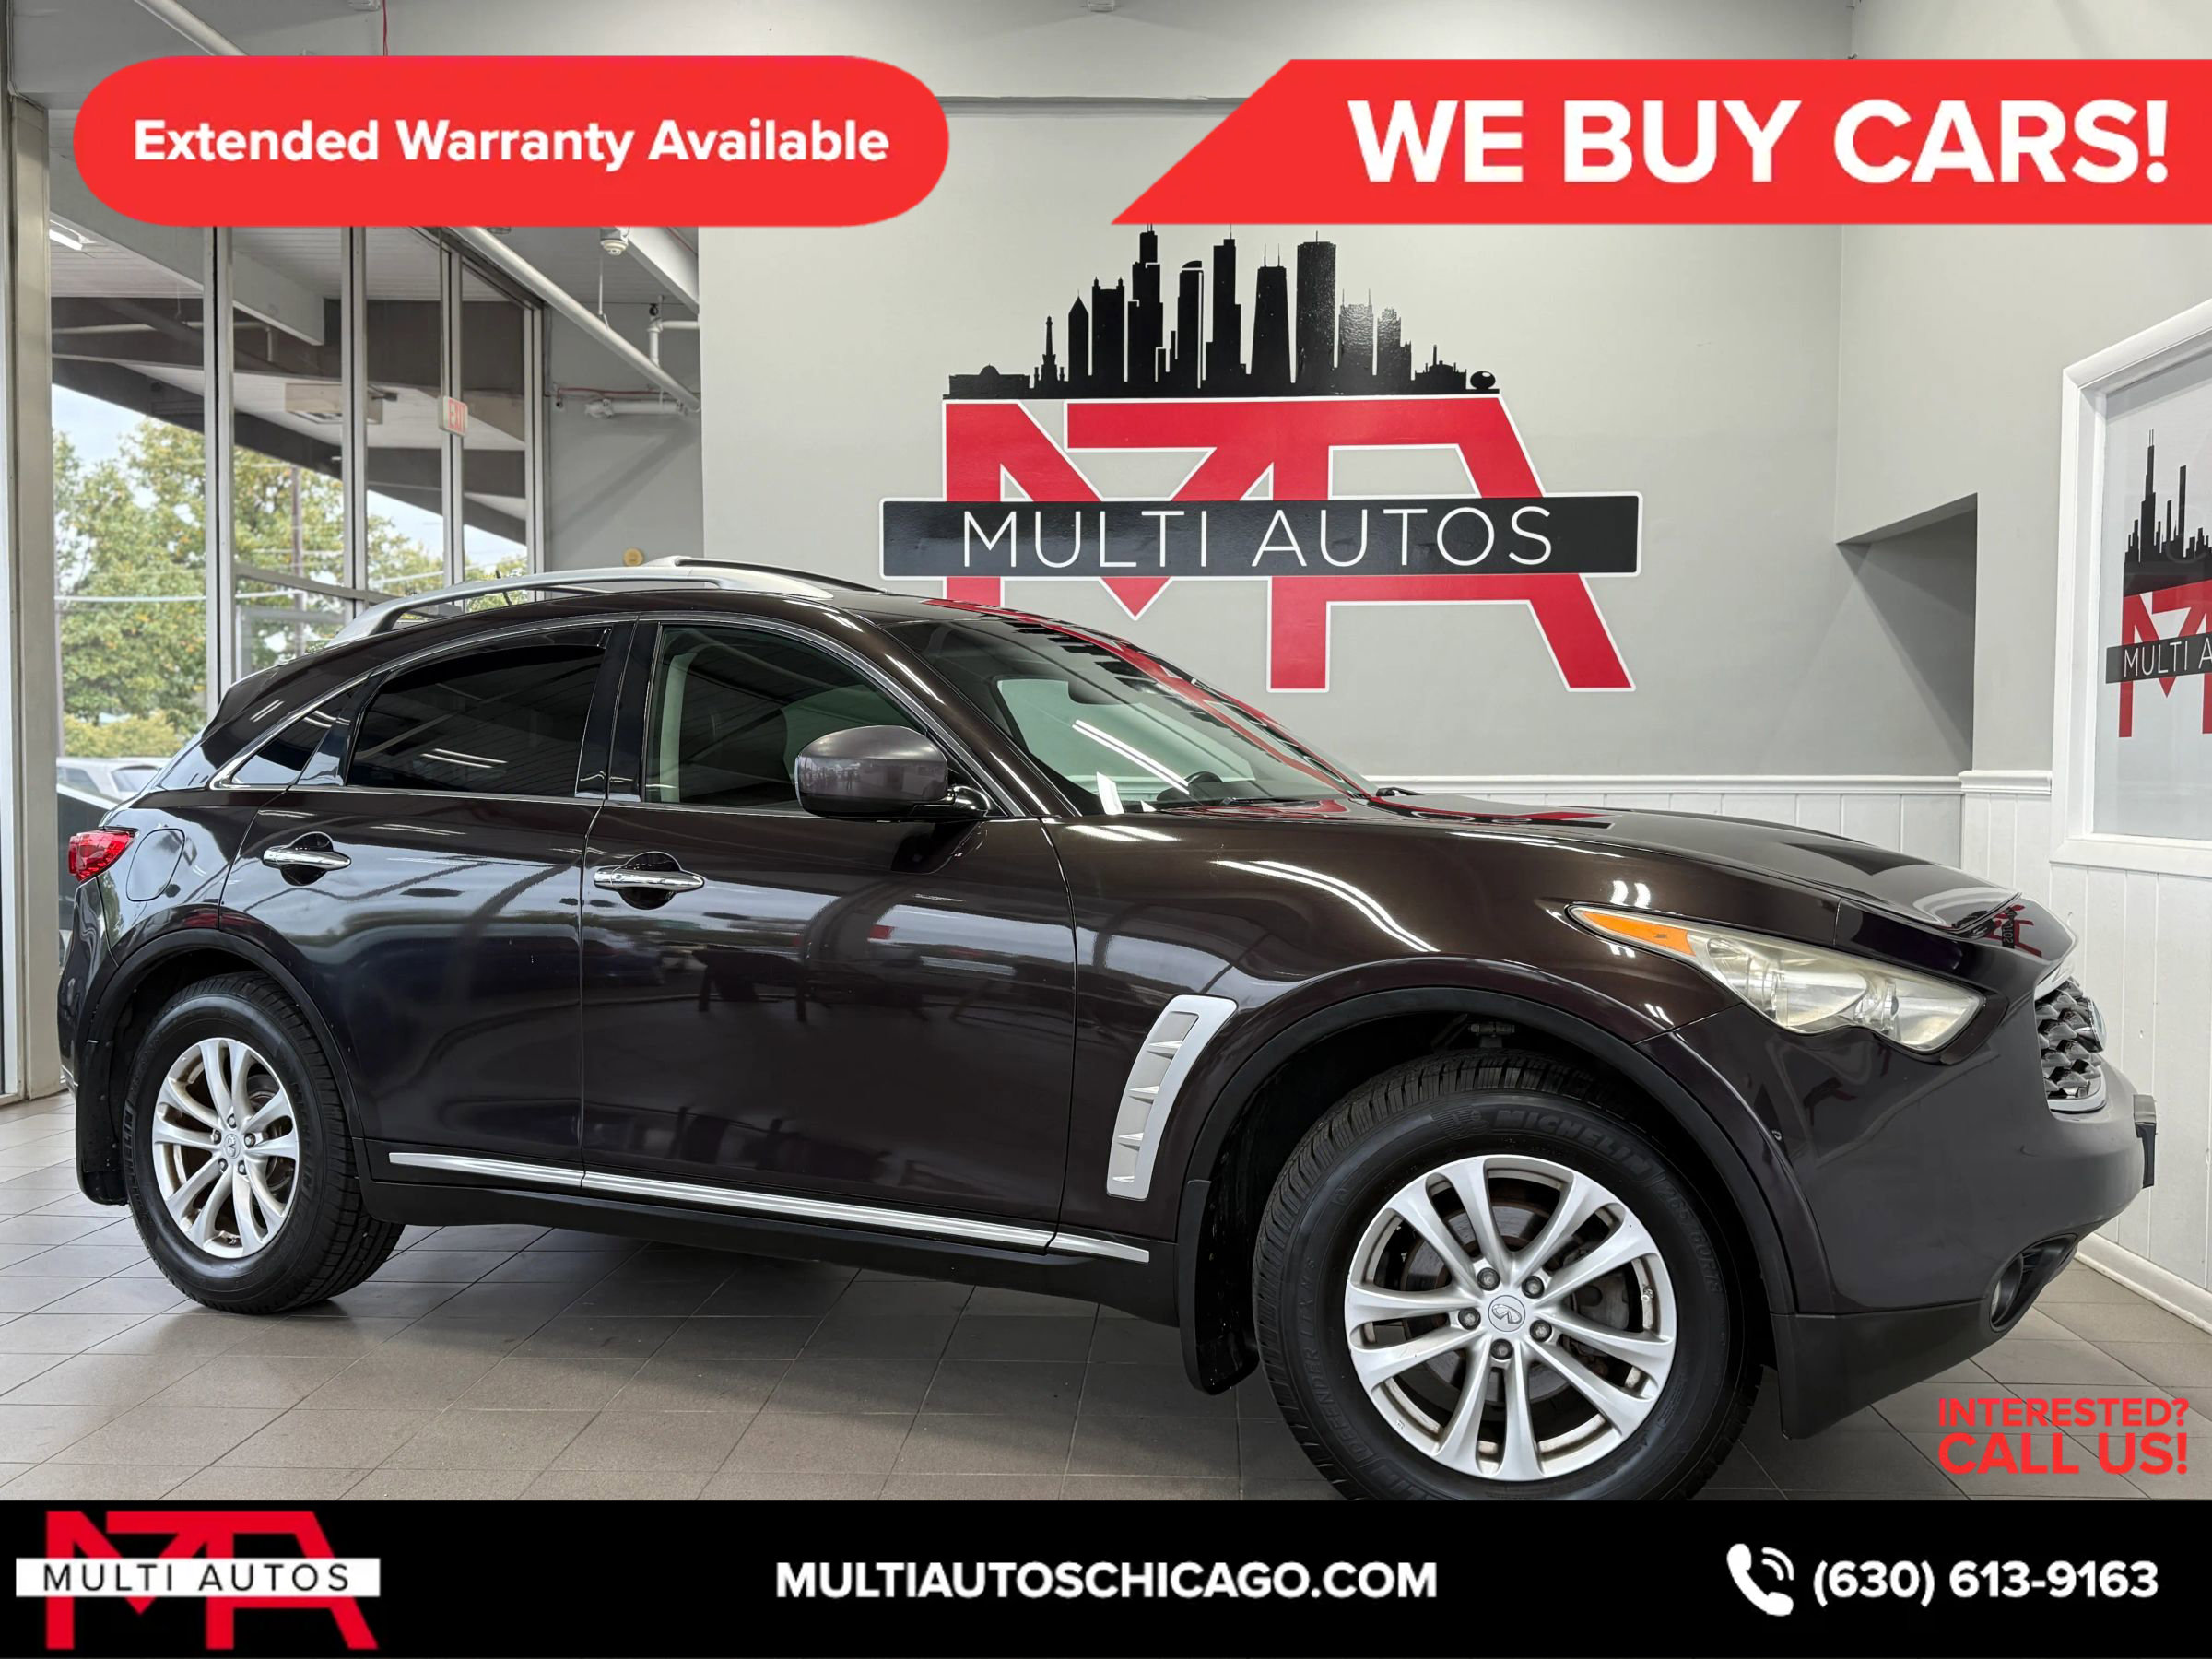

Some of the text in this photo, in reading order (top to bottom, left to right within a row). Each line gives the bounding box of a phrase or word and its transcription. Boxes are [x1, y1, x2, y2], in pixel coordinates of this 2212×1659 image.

[447, 398, 466, 433] EXIT
[963, 505, 1554, 569] MULTI AUTOS
[2123, 641, 2188, 678] MULTI
[1492, 1109, 1666, 1177] MICHELIN
[1302, 1346, 1369, 1460] DEFENDER
